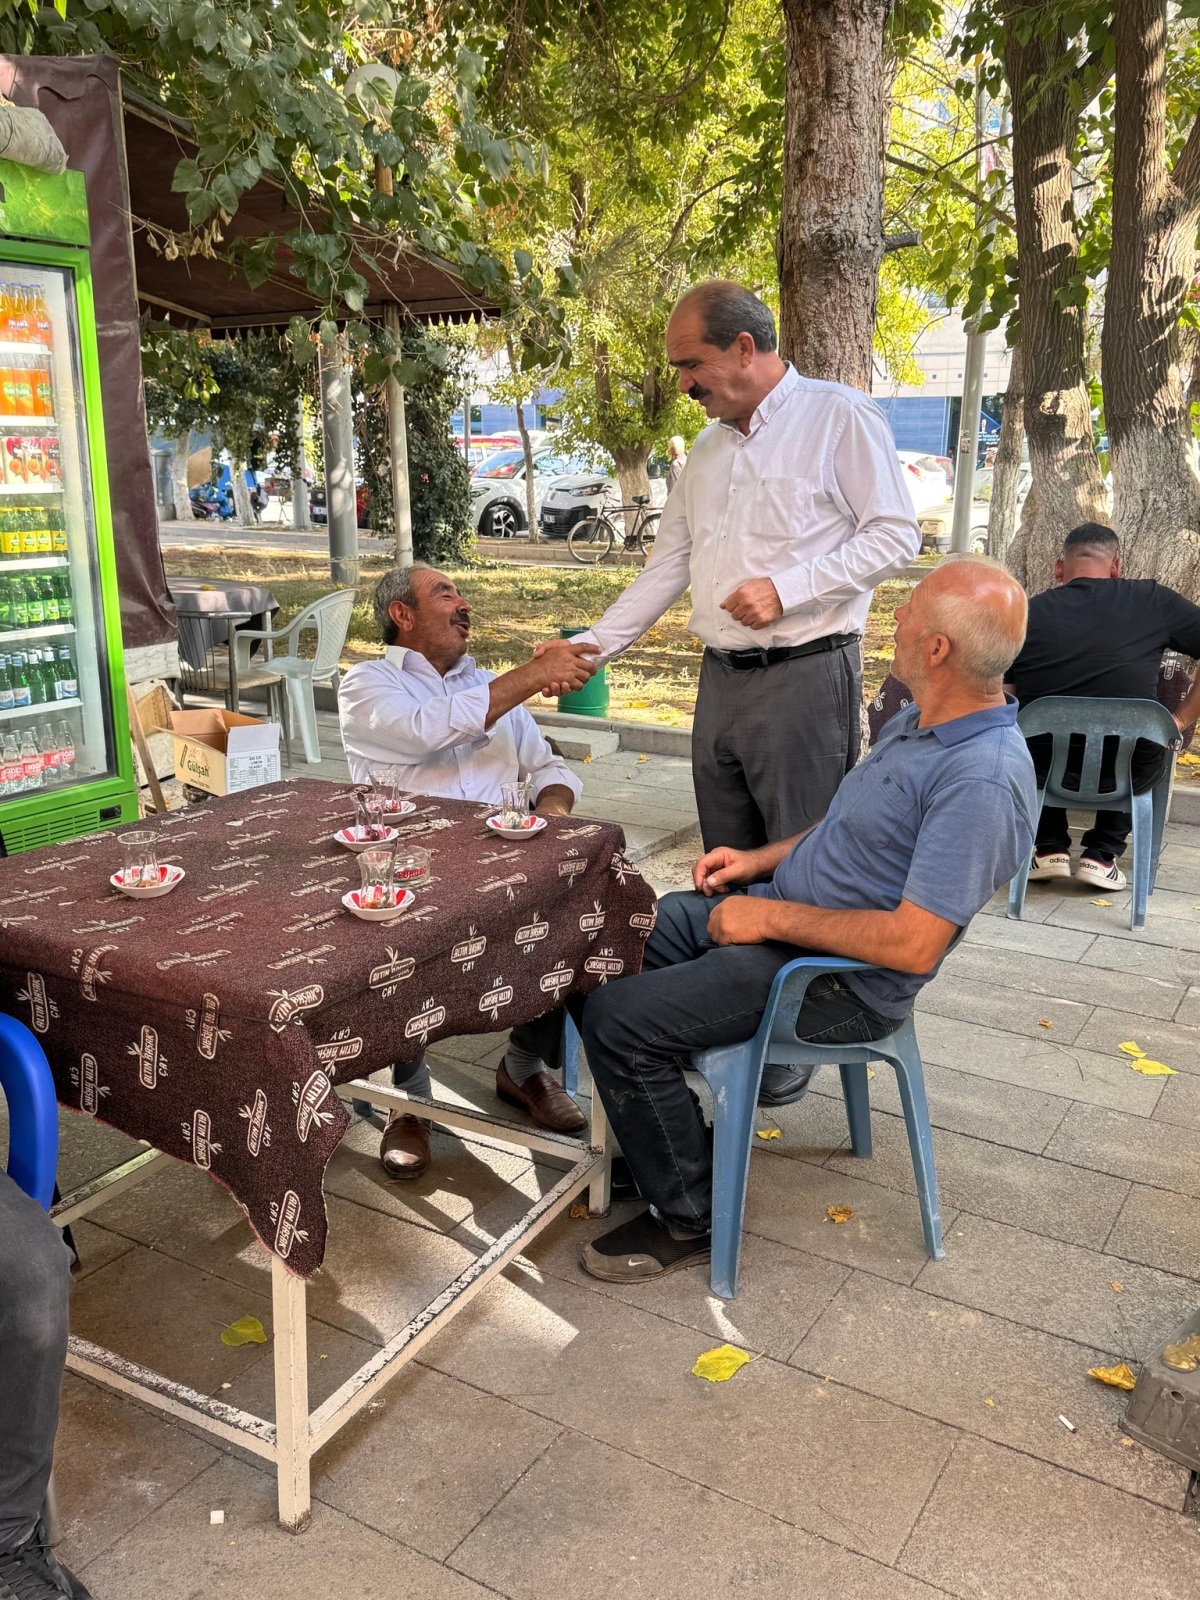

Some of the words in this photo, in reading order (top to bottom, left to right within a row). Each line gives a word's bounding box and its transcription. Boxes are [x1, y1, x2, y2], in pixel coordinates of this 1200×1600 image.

[144, 1033, 155, 1061] BAŞAK
[143, 1060, 153, 1085] ALTIN
[158, 1054, 168, 1077] ÇAY
[285, 1195, 298, 1222] ALTIN
